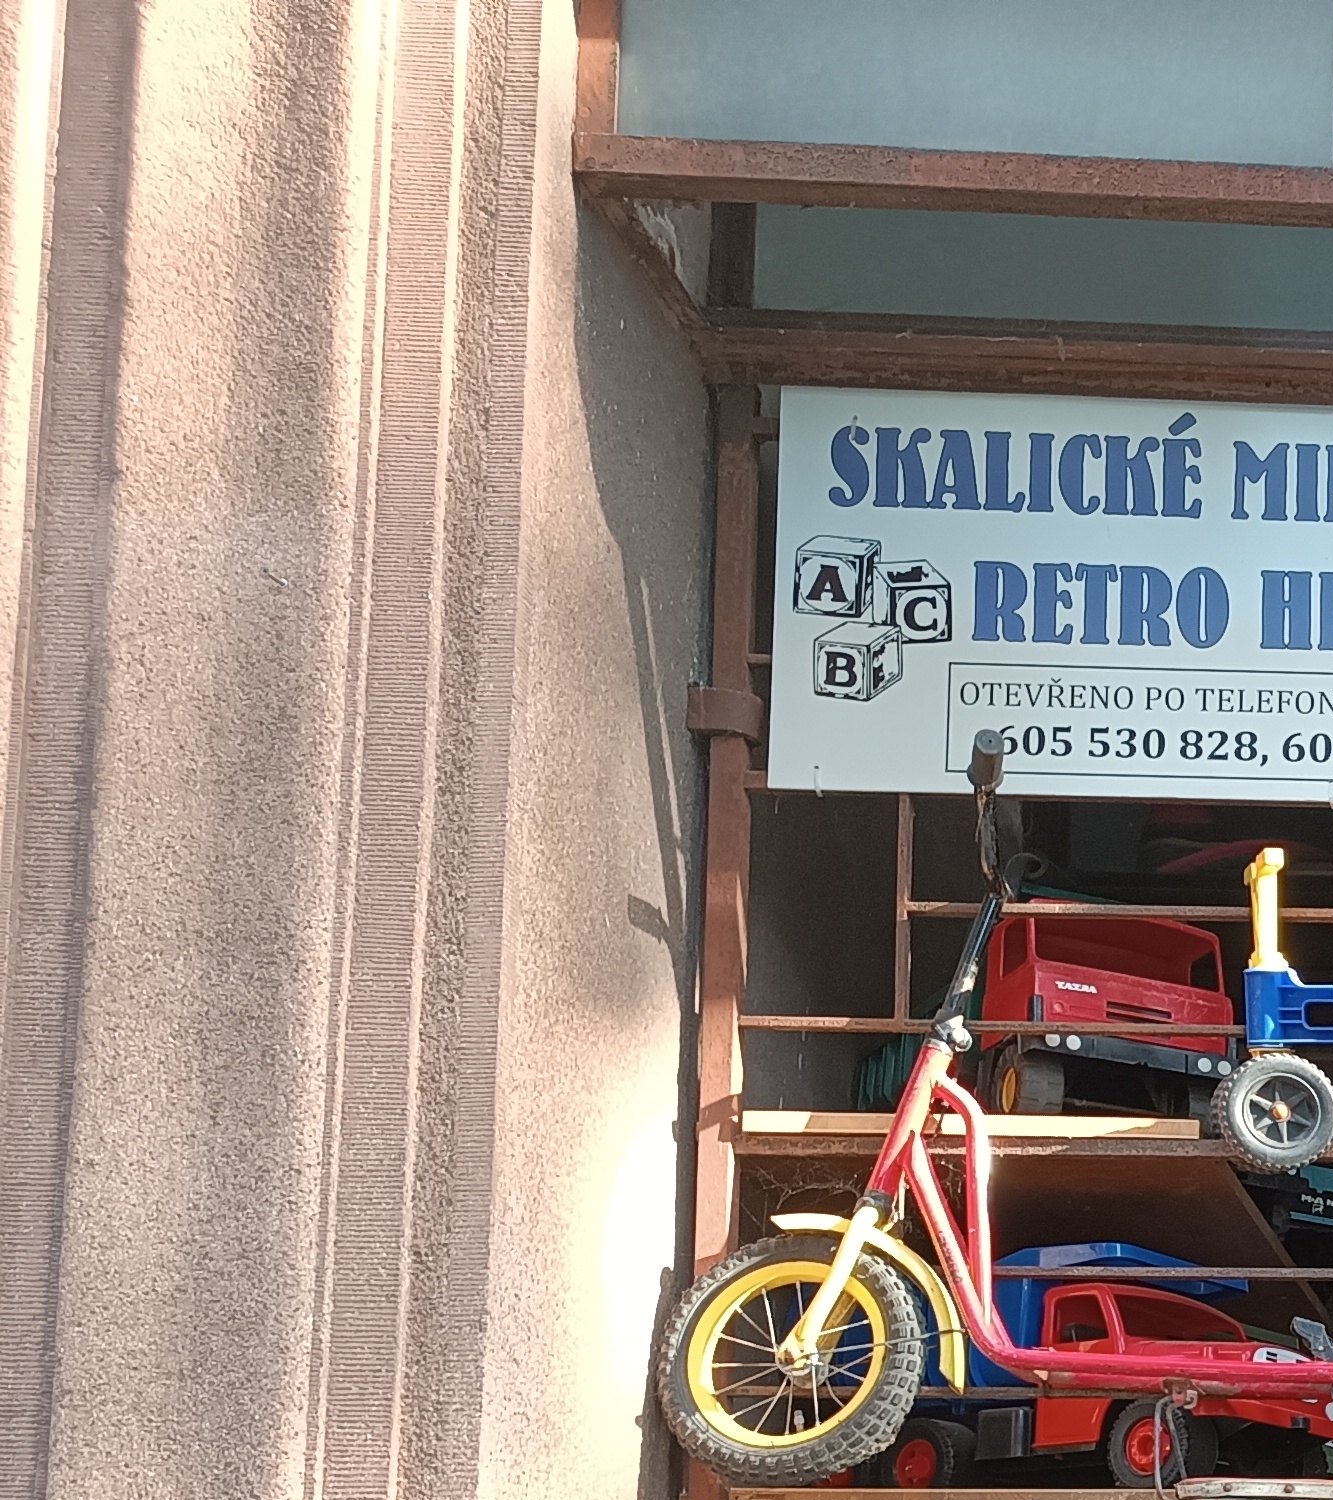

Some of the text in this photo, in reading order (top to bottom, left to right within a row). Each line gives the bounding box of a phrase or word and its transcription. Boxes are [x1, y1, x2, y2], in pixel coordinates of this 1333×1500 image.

[828, 412, 1203, 520] SKALICKÉ
[805, 564, 848, 603] A
[903, 596, 938, 632] C
[972, 560, 1230, 649] RETRO
[824, 650, 858, 688] B
[959, 678, 1134, 711] OTEVŘENO
[1145, 687, 1185, 712] PO
[1000, 724, 1073, 757] 605
[1088, 726, 1166, 759] 530
[1179, 729, 1269, 767] 828,
